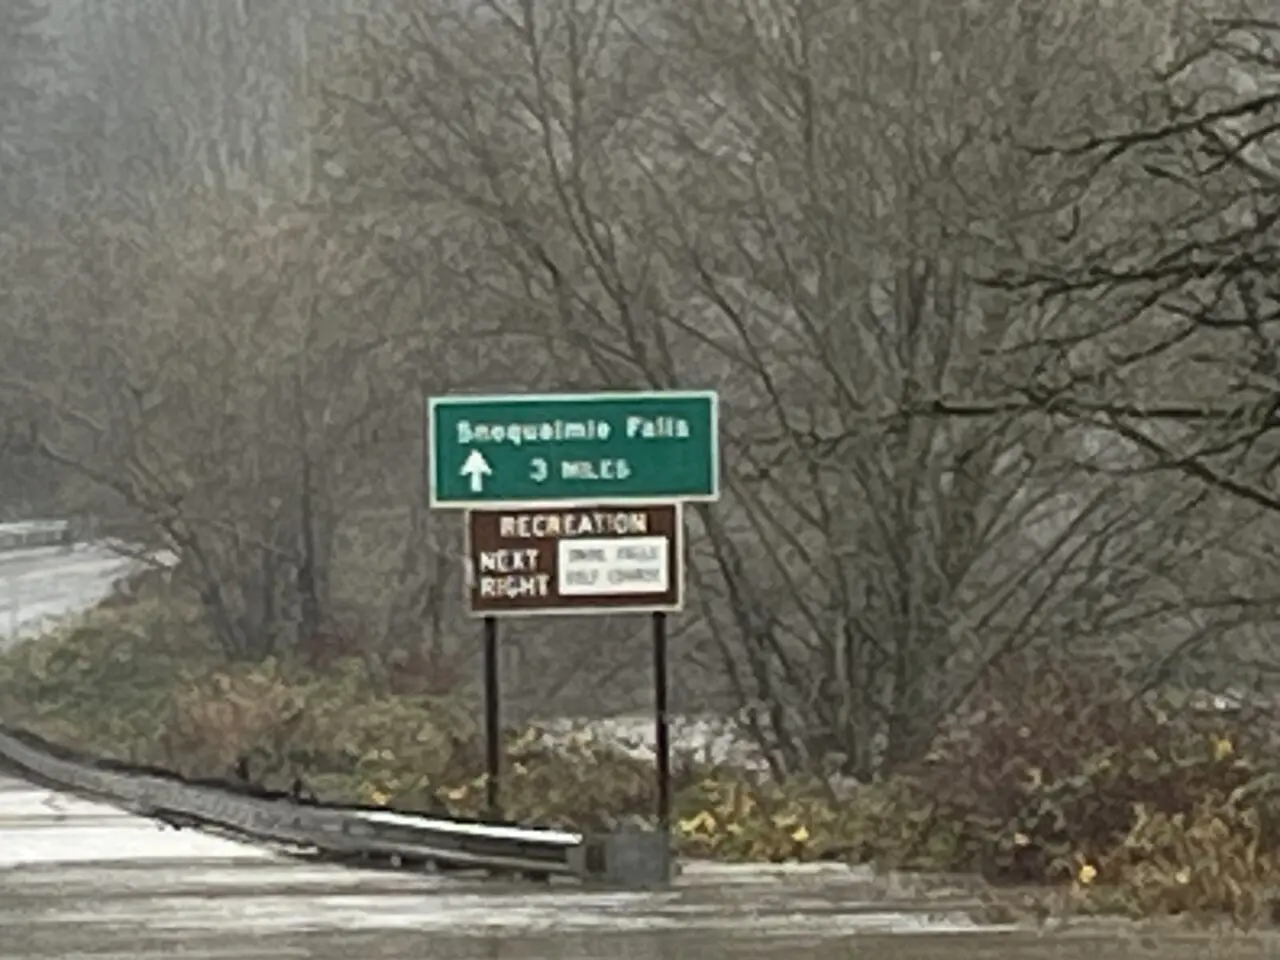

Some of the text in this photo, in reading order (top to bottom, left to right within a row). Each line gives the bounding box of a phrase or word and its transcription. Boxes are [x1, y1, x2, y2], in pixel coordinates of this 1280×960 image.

[626, 416, 690, 438] Falls
[530, 458, 631, 482] 3 MILES
[500, 513, 648, 537] RECREATION
[480, 549, 540, 573] NEXT
[480, 576, 550, 598] RIGHT
